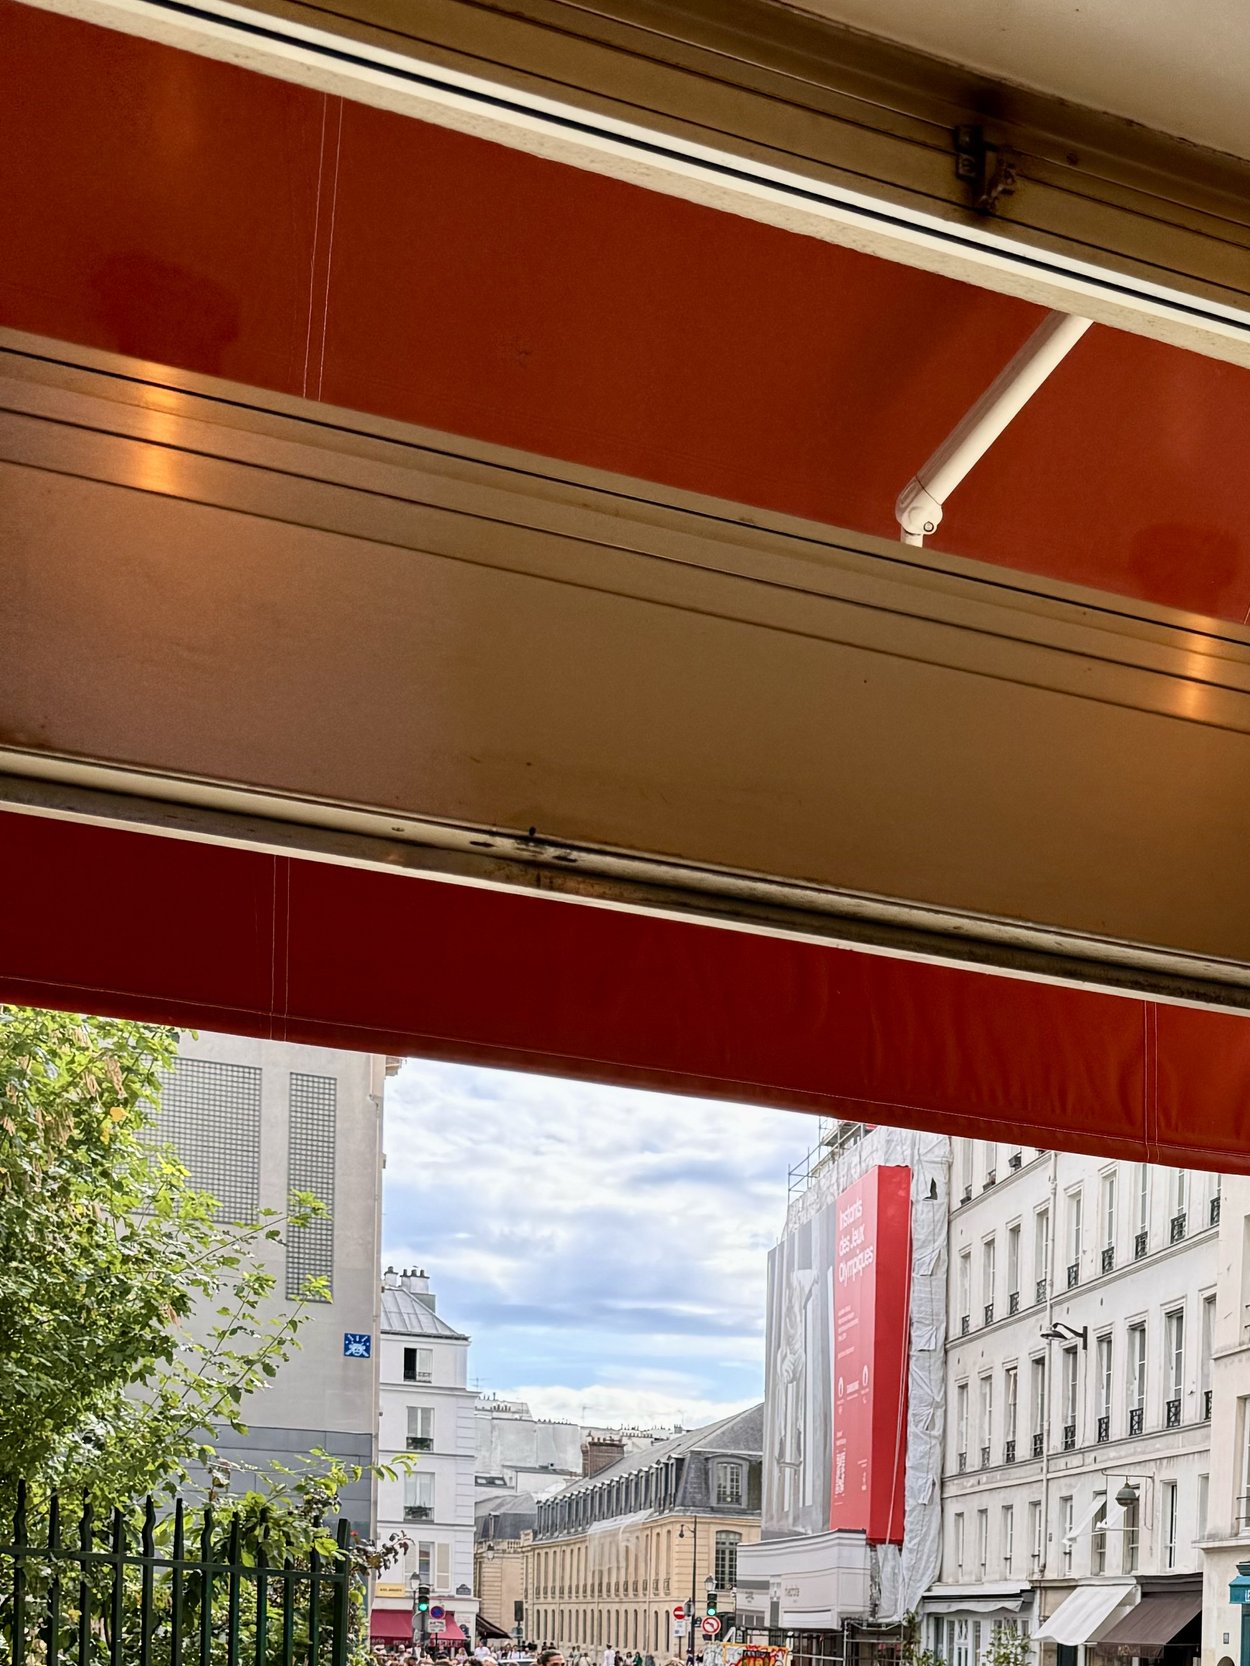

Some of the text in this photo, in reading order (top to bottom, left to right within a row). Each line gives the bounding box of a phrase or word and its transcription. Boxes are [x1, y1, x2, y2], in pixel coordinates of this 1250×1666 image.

[840, 1197, 863, 1231] Instants
[840, 1224, 864, 1256] des Jeux
[839, 1245, 874, 1287] Olympiques
